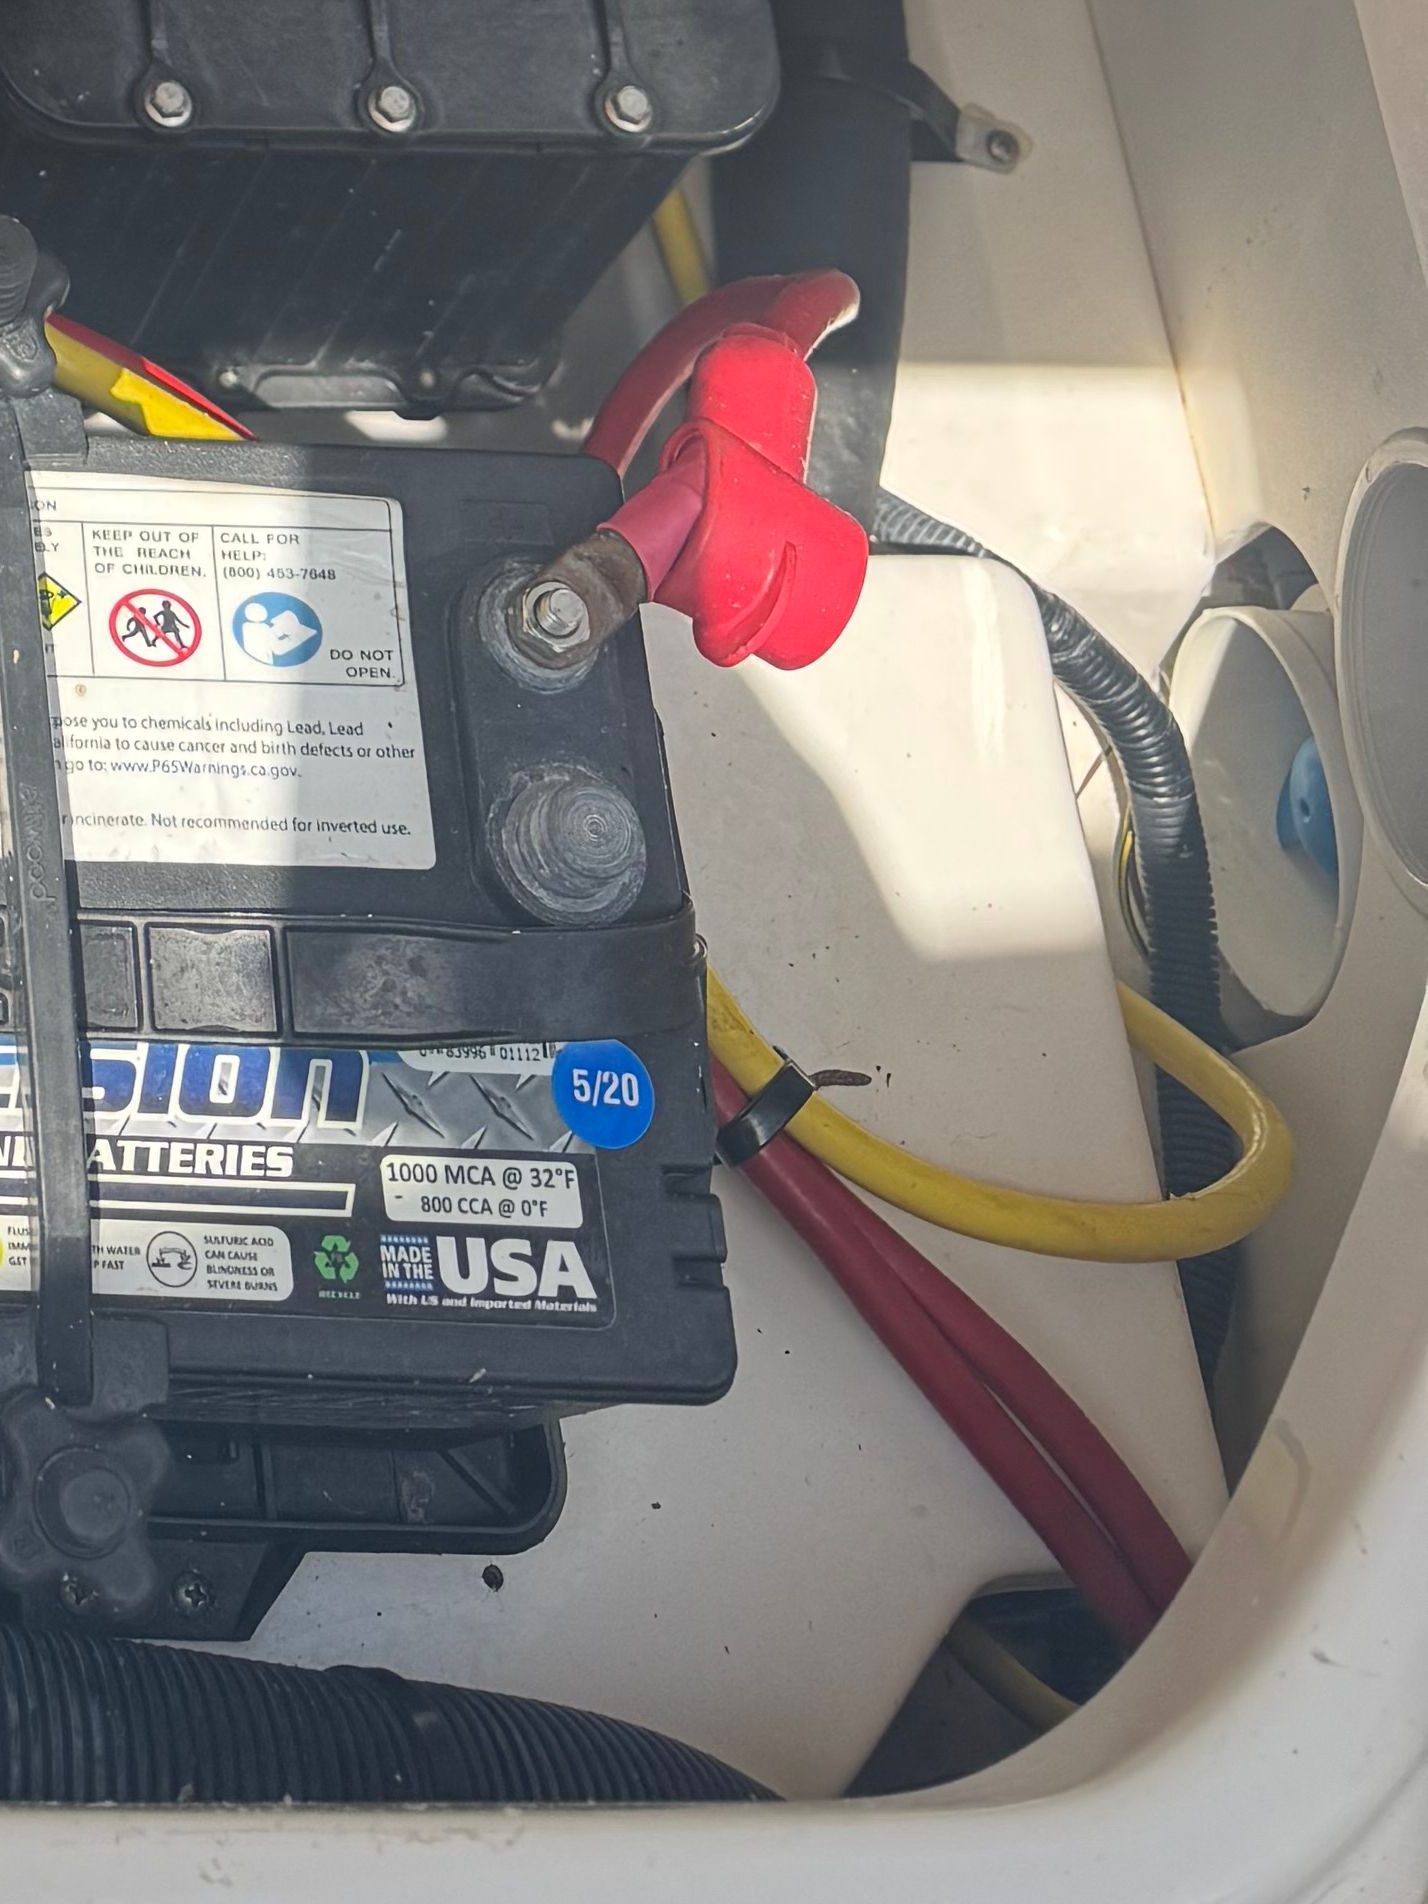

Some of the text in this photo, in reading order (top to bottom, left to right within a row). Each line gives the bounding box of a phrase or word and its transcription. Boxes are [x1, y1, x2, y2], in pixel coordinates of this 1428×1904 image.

[92, 529, 200, 544] KEEP OUT OF
[220, 532, 300, 546] CALL FOR
[93, 545, 124, 558] THE
[94, 562, 115, 574] OF
[329, 647, 394, 662] DO NOT
[572, 1068, 639, 1107] 5/20
[86, 1138, 294, 1178] ATTERIES
[386, 1162, 575, 1190] 1000 MCA @ 32°F
[421, 1195, 548, 1218] 800 CCA @ 0°F
[380, 1245, 432, 1263] MADE
[383, 1263, 434, 1281] IN THE
[436, 1235, 598, 1300] USA
